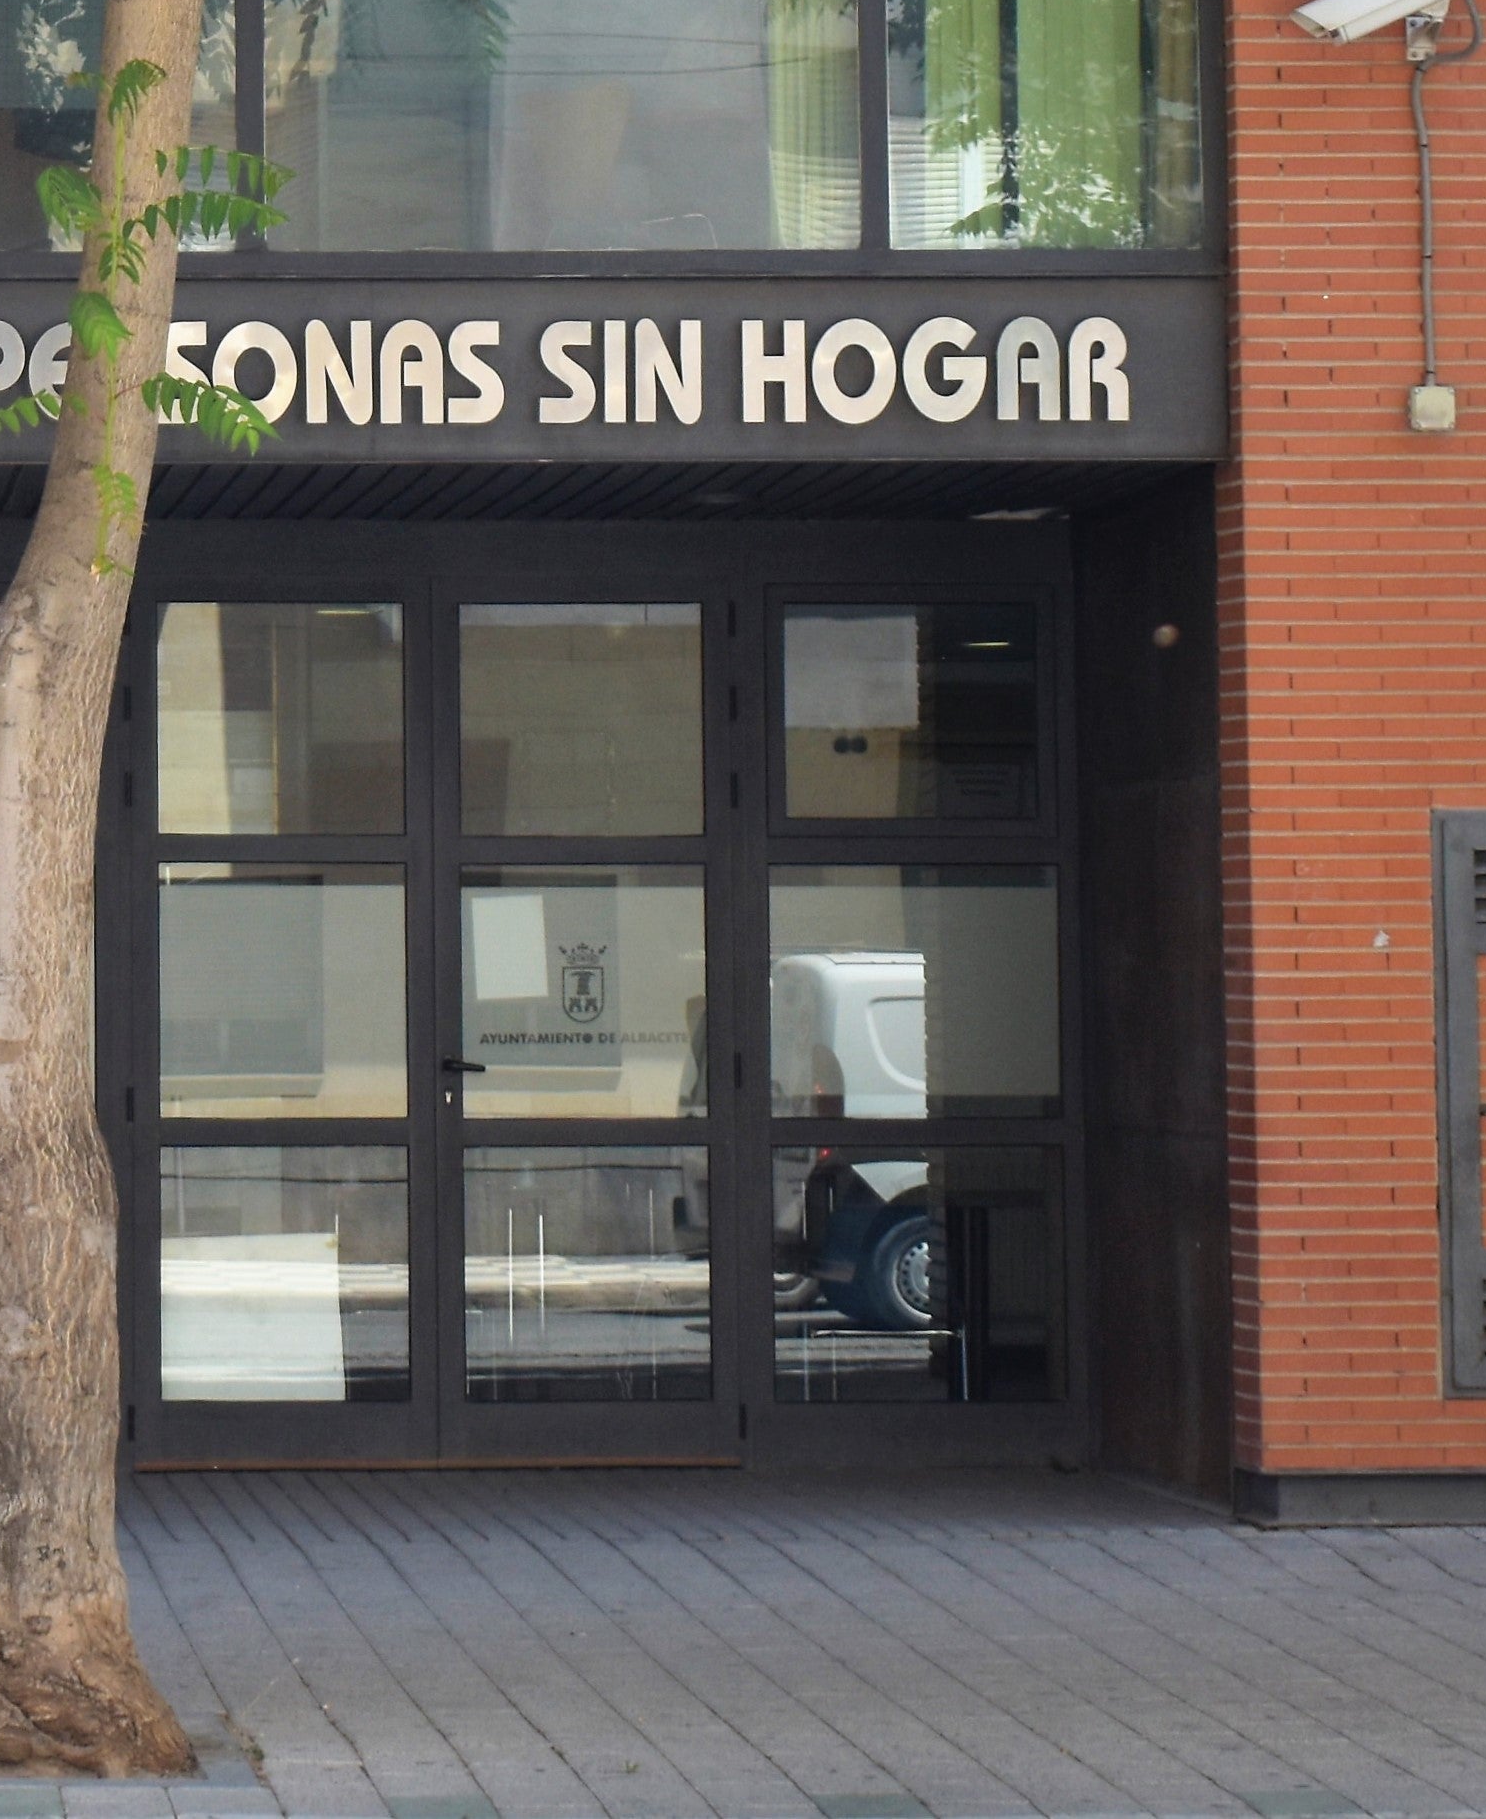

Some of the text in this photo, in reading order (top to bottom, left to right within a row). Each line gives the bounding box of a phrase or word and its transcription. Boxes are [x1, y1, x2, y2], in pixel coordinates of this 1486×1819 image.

[538, 317, 703, 425] SIN
[741, 316, 1130, 424] HOGAR
[479, 1032, 594, 1045] AYUNTAMIENTO
[597, 1032, 616, 1044] DE
